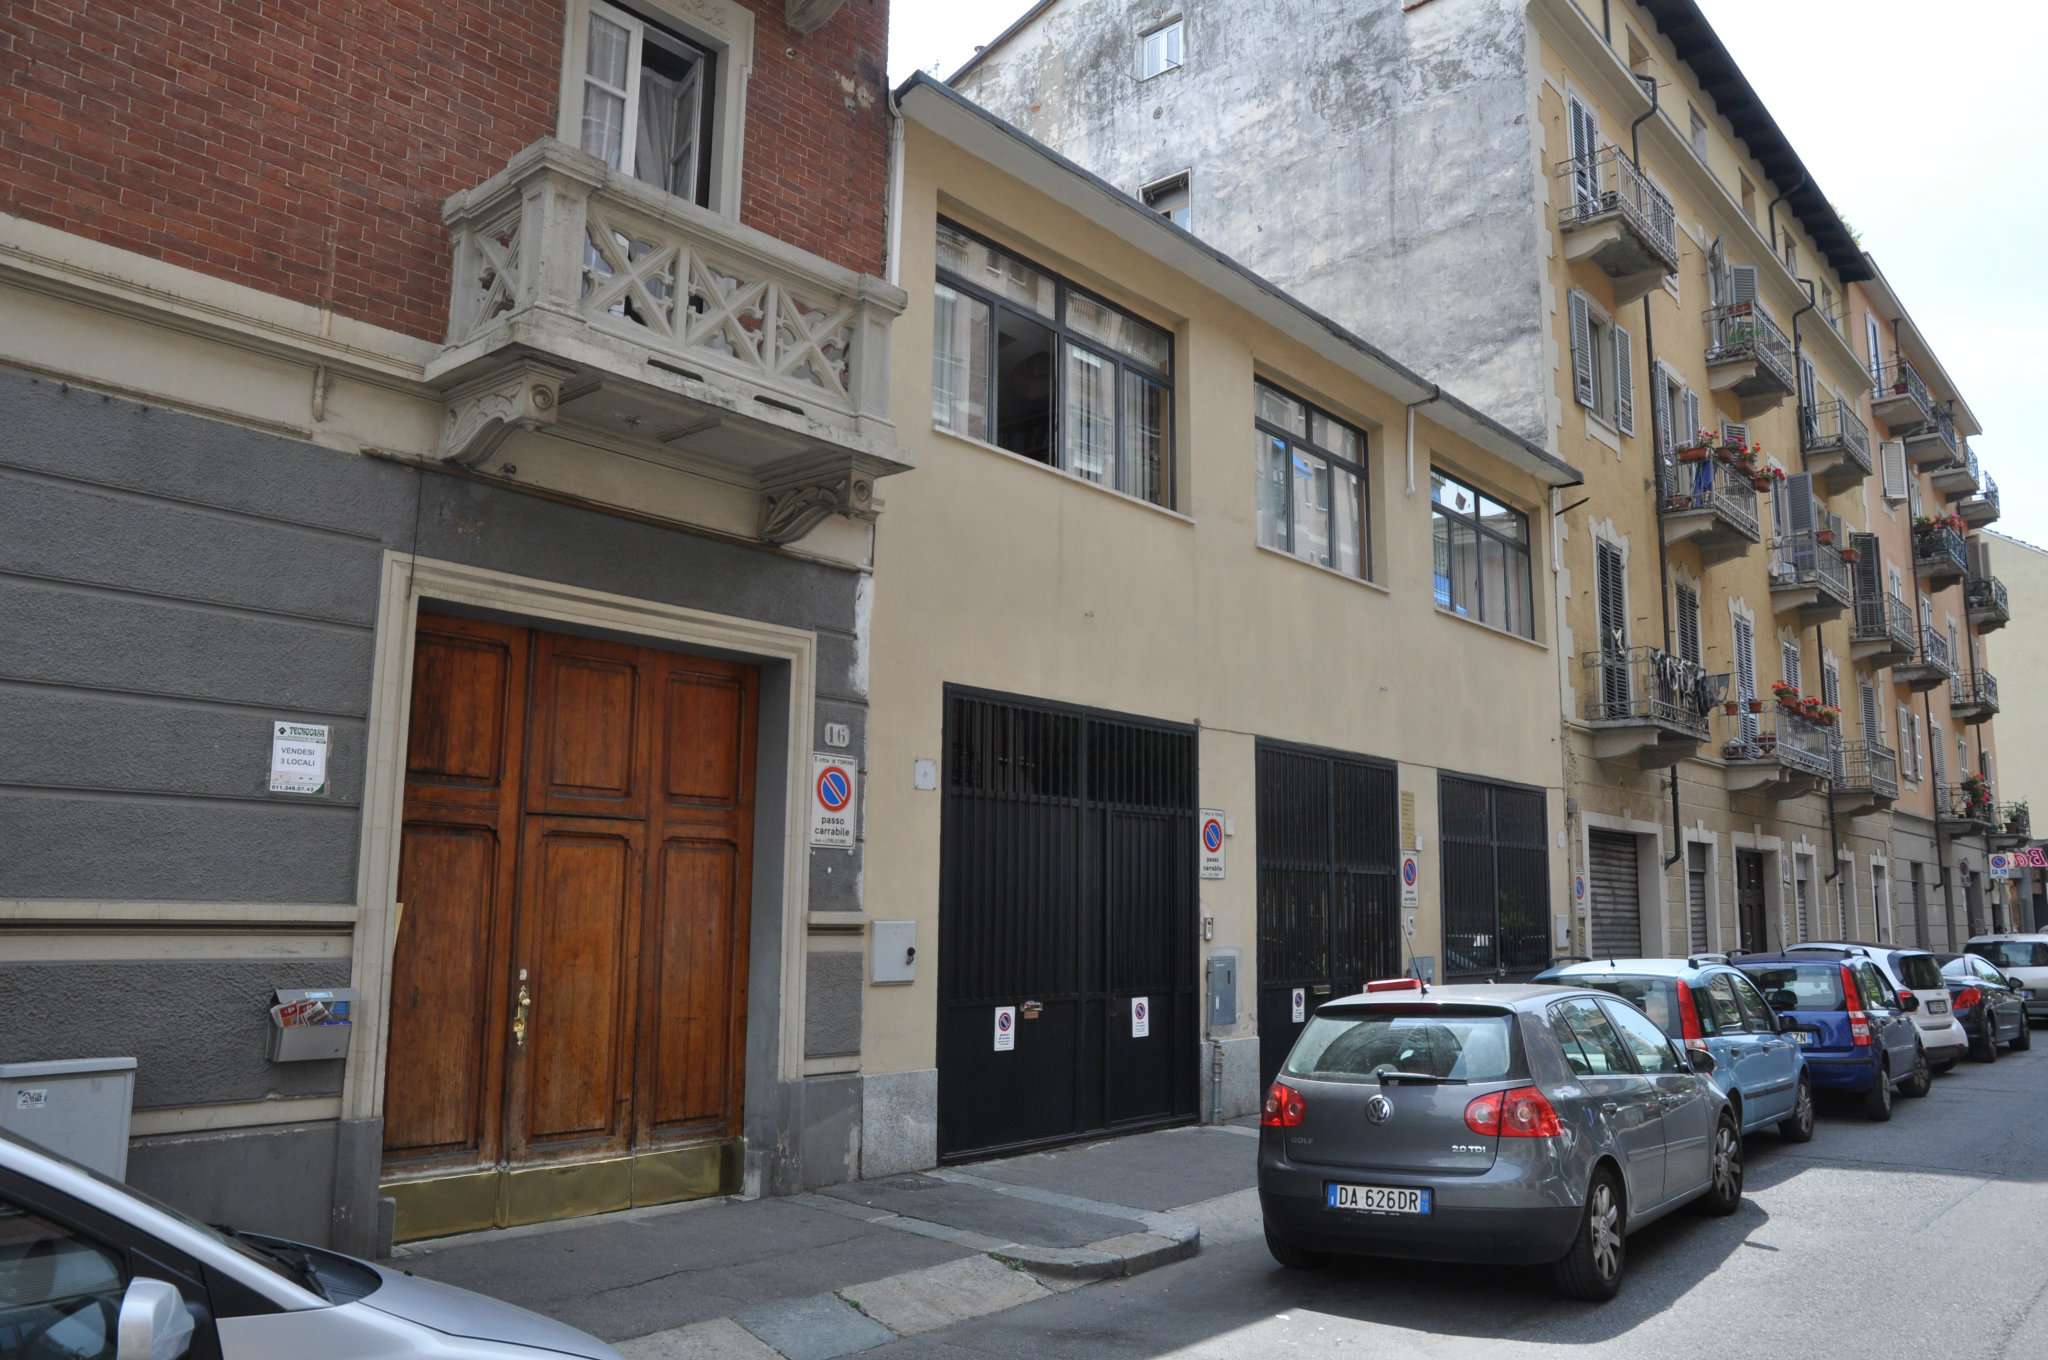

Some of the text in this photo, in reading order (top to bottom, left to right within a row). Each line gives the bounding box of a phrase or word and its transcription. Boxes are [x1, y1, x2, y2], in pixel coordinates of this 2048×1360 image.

[828, 725, 847, 744] 16
[281, 746, 315, 756] VENDESI
[286, 758, 315, 767] LOCALI
[821, 816, 845, 825] passo
[814, 827, 850, 837] carrabile
[1468, 1145, 1486, 1153] TDI
[1338, 1186, 1358, 1207] DA
[1365, 1188, 1418, 1211] 626DR
